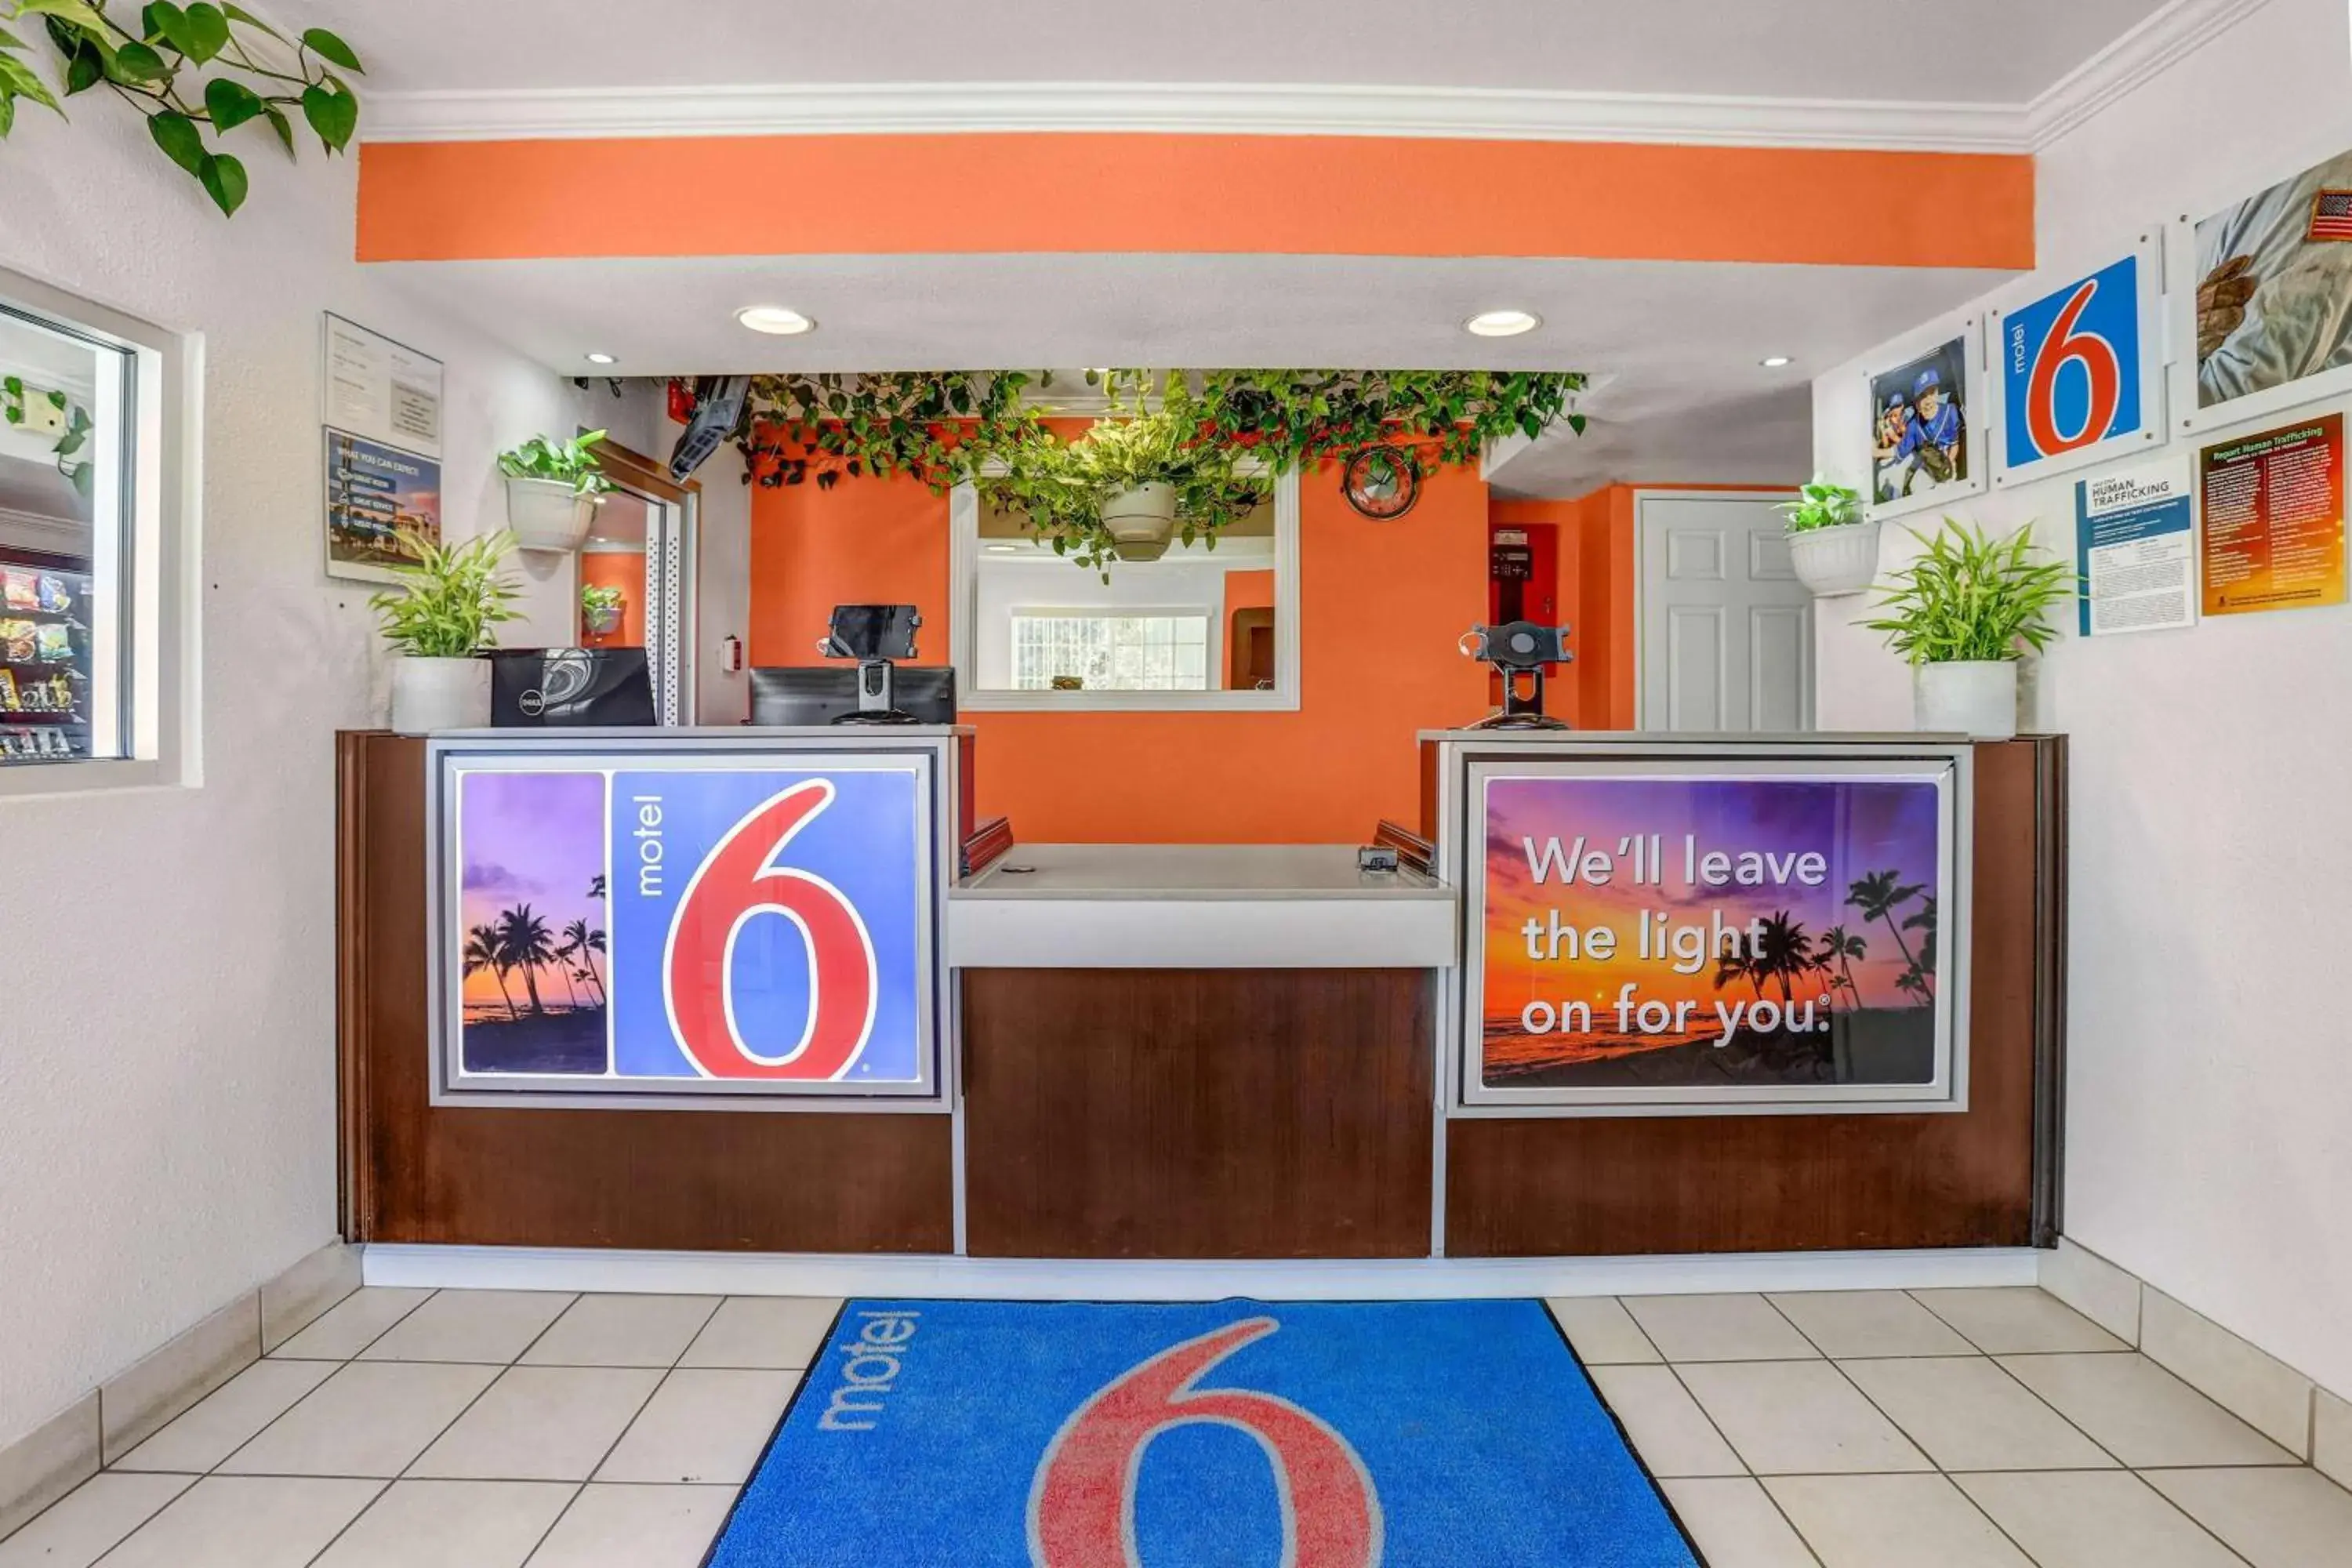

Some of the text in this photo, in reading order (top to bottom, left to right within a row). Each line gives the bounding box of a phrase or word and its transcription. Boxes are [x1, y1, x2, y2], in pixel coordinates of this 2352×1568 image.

[2011, 323, 2025, 375] motel
[2025, 278, 2121, 458] 6
[377, 458, 392, 468] CAN
[2213, 447, 2240, 461] Report
[2243, 440, 2272, 454] Human
[2274, 427, 2322, 445] Trafficking
[2092, 479, 2134, 497] HUMAN
[2094, 481, 2169, 507] TRAFFICKING
[633, 794, 663, 897] motel
[1685, 834, 1828, 887] leave
[662, 777, 879, 1081] 6
[1521, 909, 1768, 975] the light
[1521, 1000, 1592, 1034] on
[1613, 983, 1699, 1035] for
[817, 1309, 922, 1432] motel
[1025, 1316, 1385, 1568] 6
